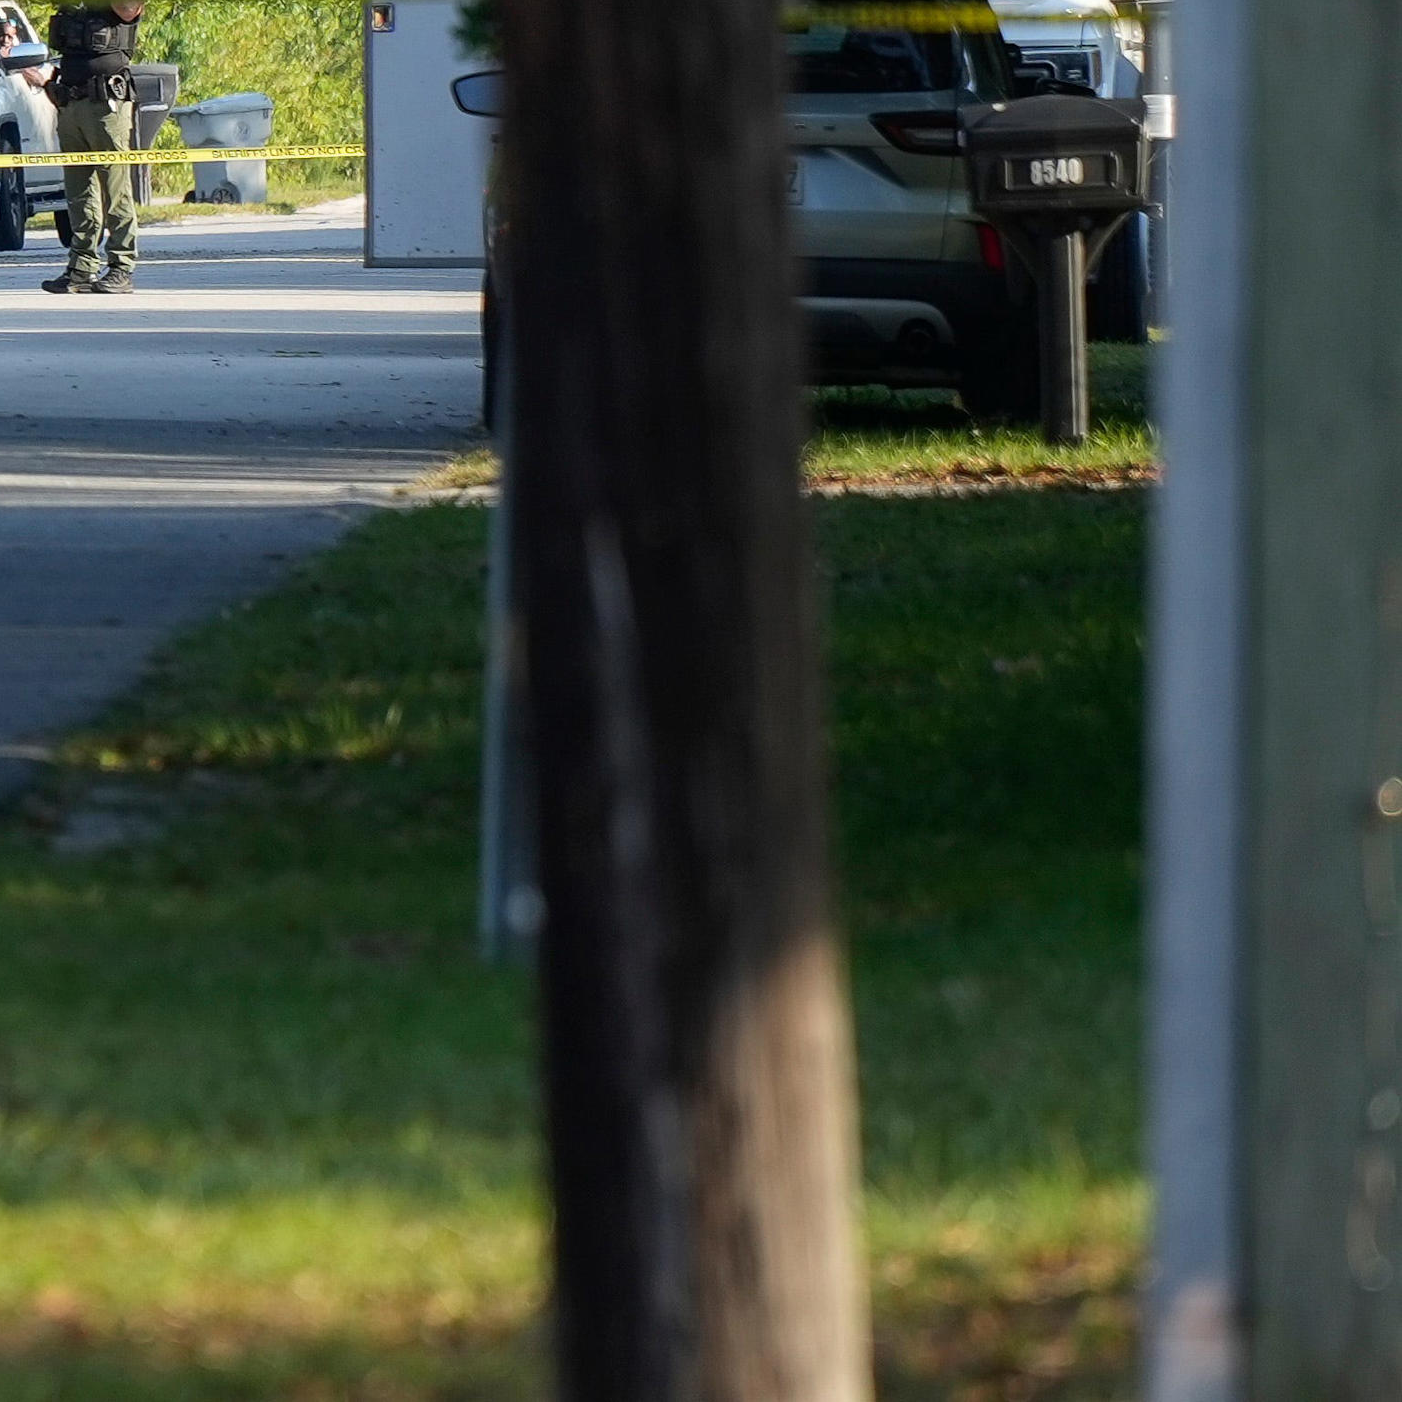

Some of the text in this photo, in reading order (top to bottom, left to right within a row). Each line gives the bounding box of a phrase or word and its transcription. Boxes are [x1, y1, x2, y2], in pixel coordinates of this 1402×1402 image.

[98, 154, 116, 163] DO
[119, 153, 143, 162] NOT
[146, 151, 188, 161] CROSS
[297, 147, 315, 156] DO
[317, 146, 342, 155] NOT
[1030, 156, 1084, 185] 8540
